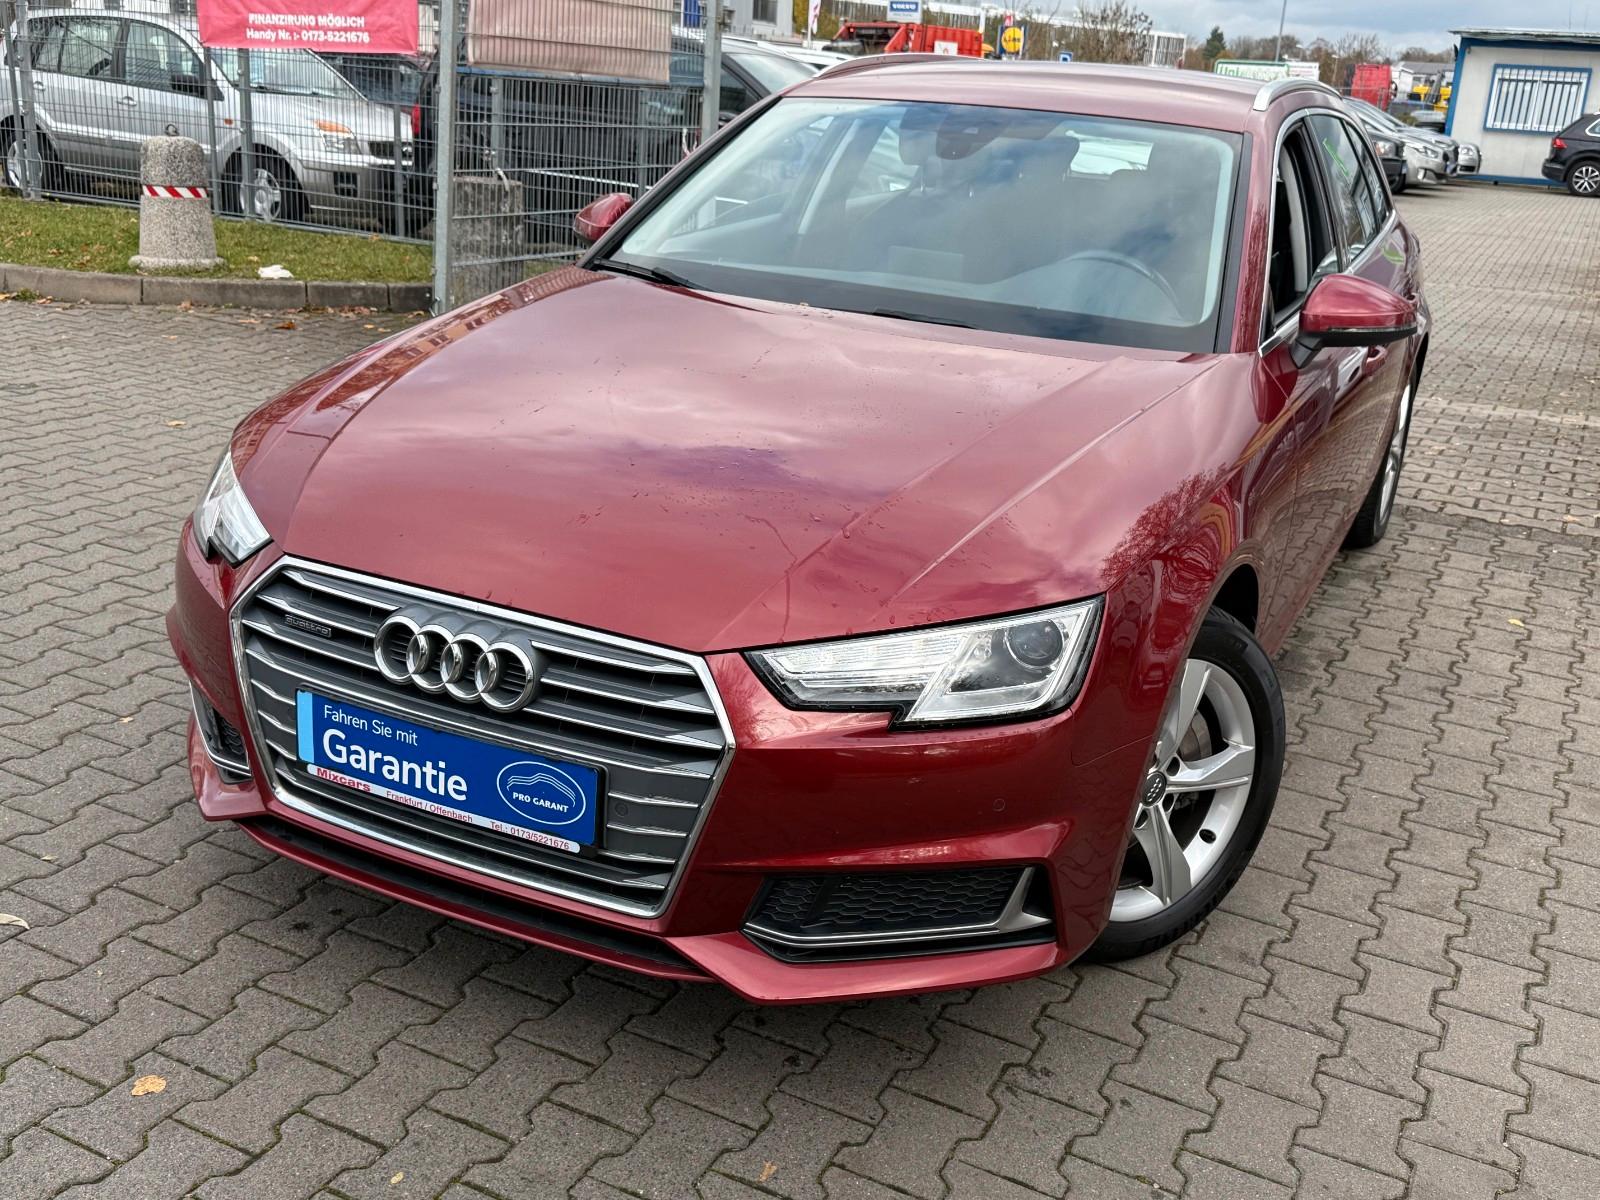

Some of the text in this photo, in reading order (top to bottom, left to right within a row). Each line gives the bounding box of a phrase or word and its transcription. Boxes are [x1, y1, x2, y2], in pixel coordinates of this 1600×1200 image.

[246, 28, 276, 42] Handy
[278, 29, 292, 40] Nr.
[301, 30, 370, 43] 0173-5221676
[249, 13, 365, 27] FINANZIRUNG MÖGLICH
[324, 704, 418, 746] Fahren Sie mit
[322, 728, 468, 801] Garantie
[316, 767, 371, 793] Mixcars
[386, 791, 423, 809] Frankfurt
[429, 803, 473, 823] Offenbach
[490, 821, 508, 833] Tel.:
[510, 826, 570, 850] 0173/5221676
[512, 791, 569, 813] PRO GARANT
